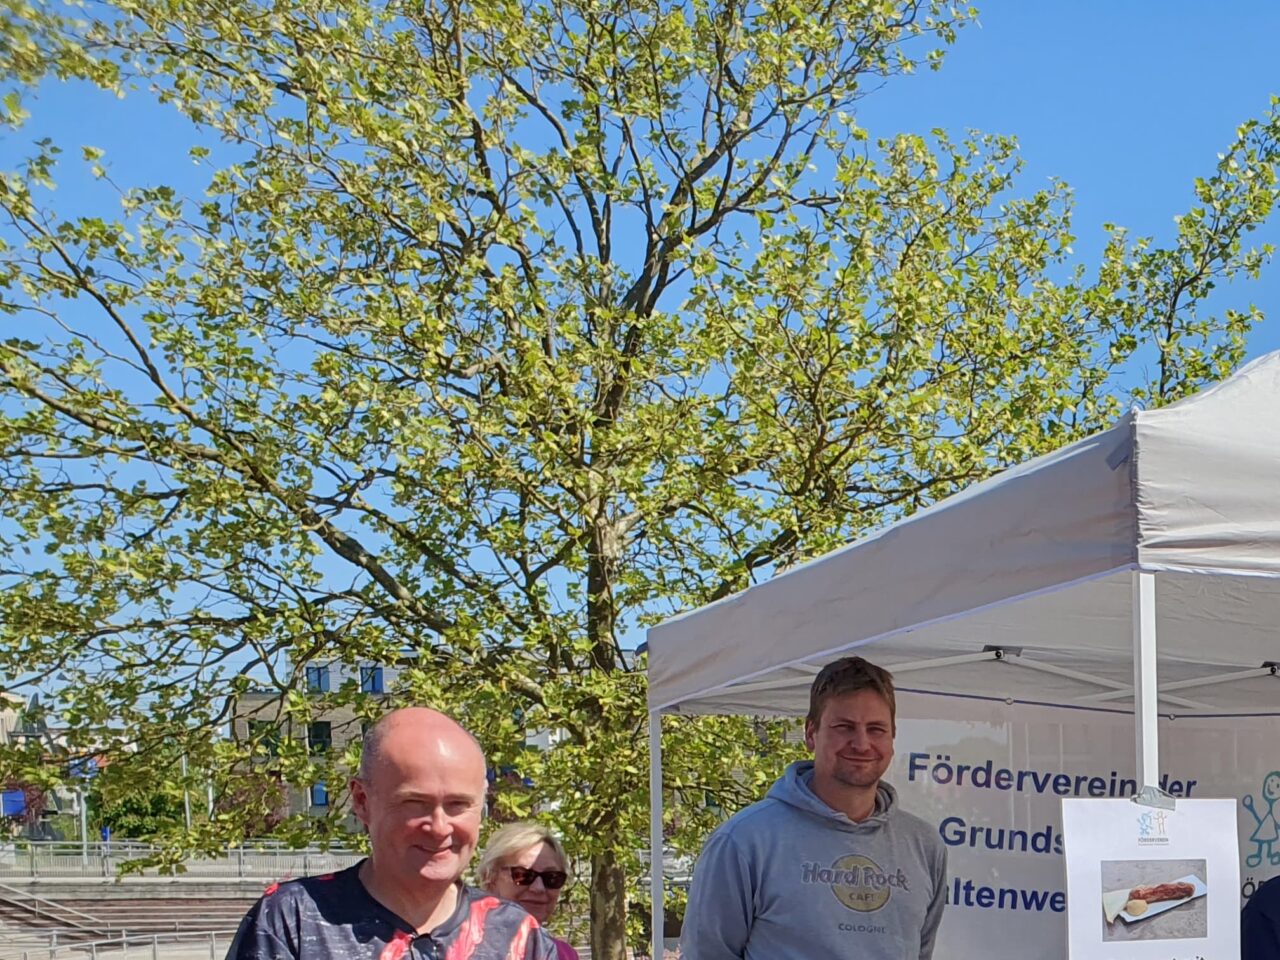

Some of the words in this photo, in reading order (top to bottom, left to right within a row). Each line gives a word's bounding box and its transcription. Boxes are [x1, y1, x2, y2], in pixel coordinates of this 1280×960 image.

[908, 752, 1138, 798] Förderverein
[802, 862, 859, 886] Hard
[864, 866, 911, 892] Rock
